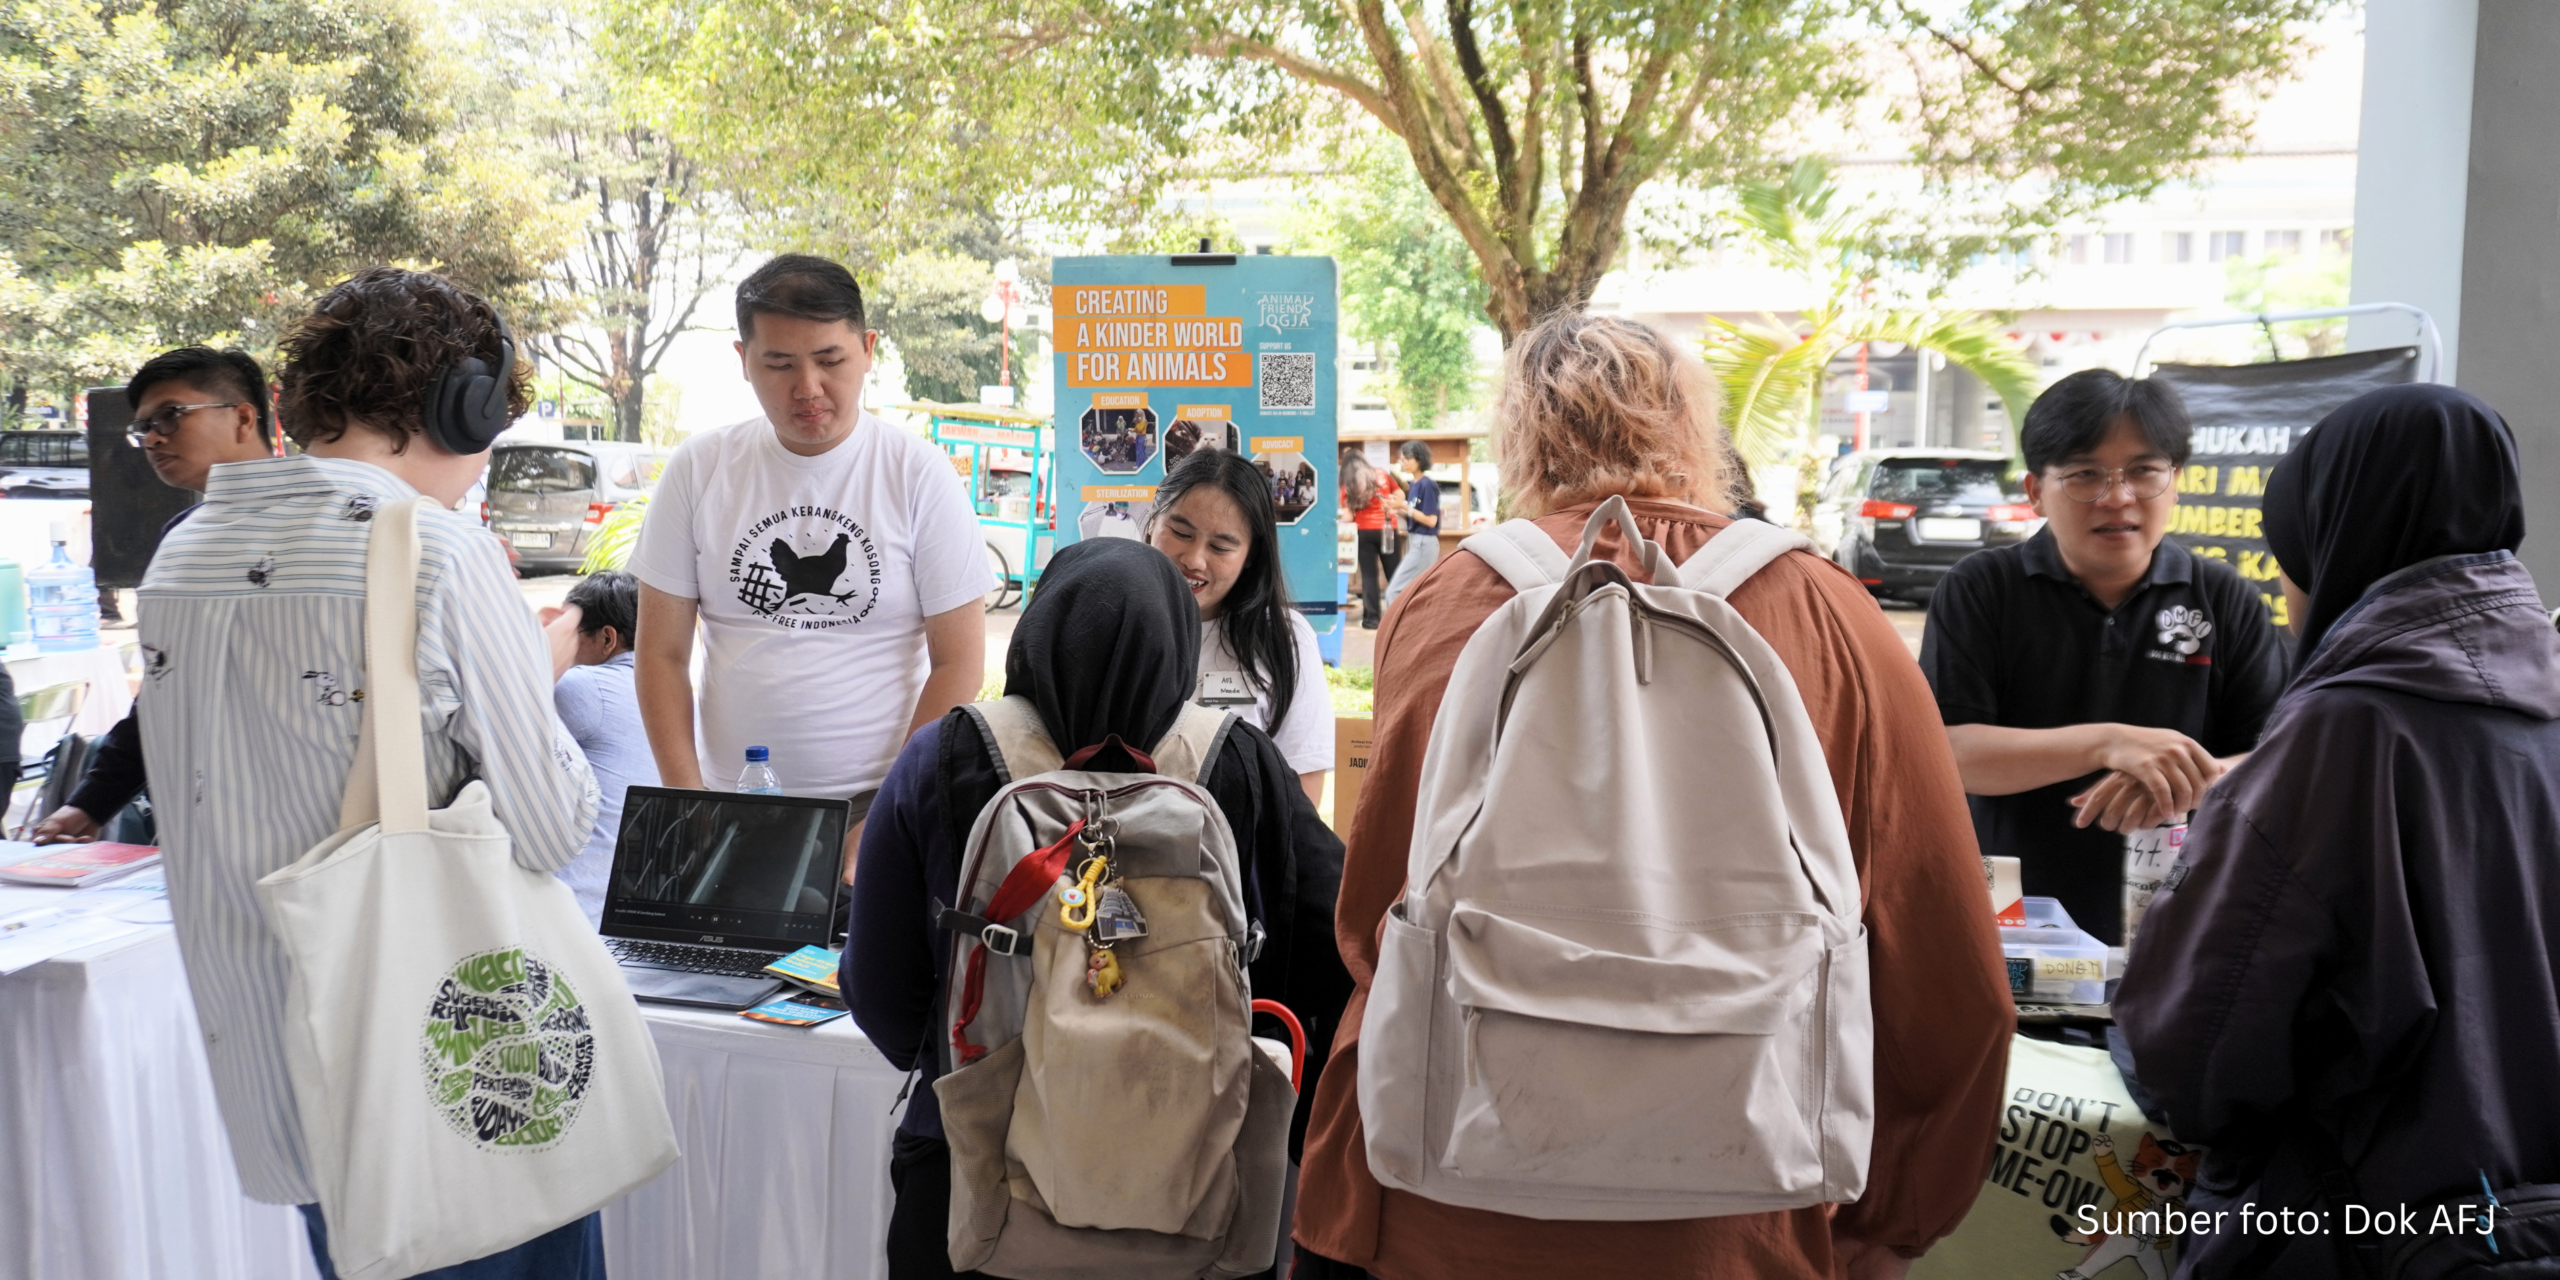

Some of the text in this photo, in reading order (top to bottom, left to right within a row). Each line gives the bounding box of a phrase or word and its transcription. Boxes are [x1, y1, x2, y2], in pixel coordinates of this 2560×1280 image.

[1075, 289, 1168, 315] CREATING
[1257, 294, 1314, 305] ANIMAL
[1260, 302, 1311, 317] FRIENDS
[1076, 322, 1243, 347] A KINDER WORLD
[1258, 313, 1310, 335] JOGJA
[1259, 342, 1292, 350] SUPPORT US
[1077, 352, 1227, 381] FOR ANIMALS
[1101, 396, 1140, 406] EDUCATION
[1186, 407, 1222, 418] ADOPTION
[1262, 440, 1294, 450] ADVOCACY
[1096, 488, 1149, 498] STERILIZATION
[730, 505, 881, 584] SAMPAI SEMUA KERANGKENG KOSONG
[699, 935, 725, 944] ASUS
[436, 979, 508, 1010] SUGENG
[430, 1000, 521, 1031] RAWUH
[498, 1039, 540, 1075] STUDY
[2012, 1087, 2121, 1134] DON'T
[494, 1112, 565, 1145] CULTURE
[2000, 1104, 2092, 1166] STOP
